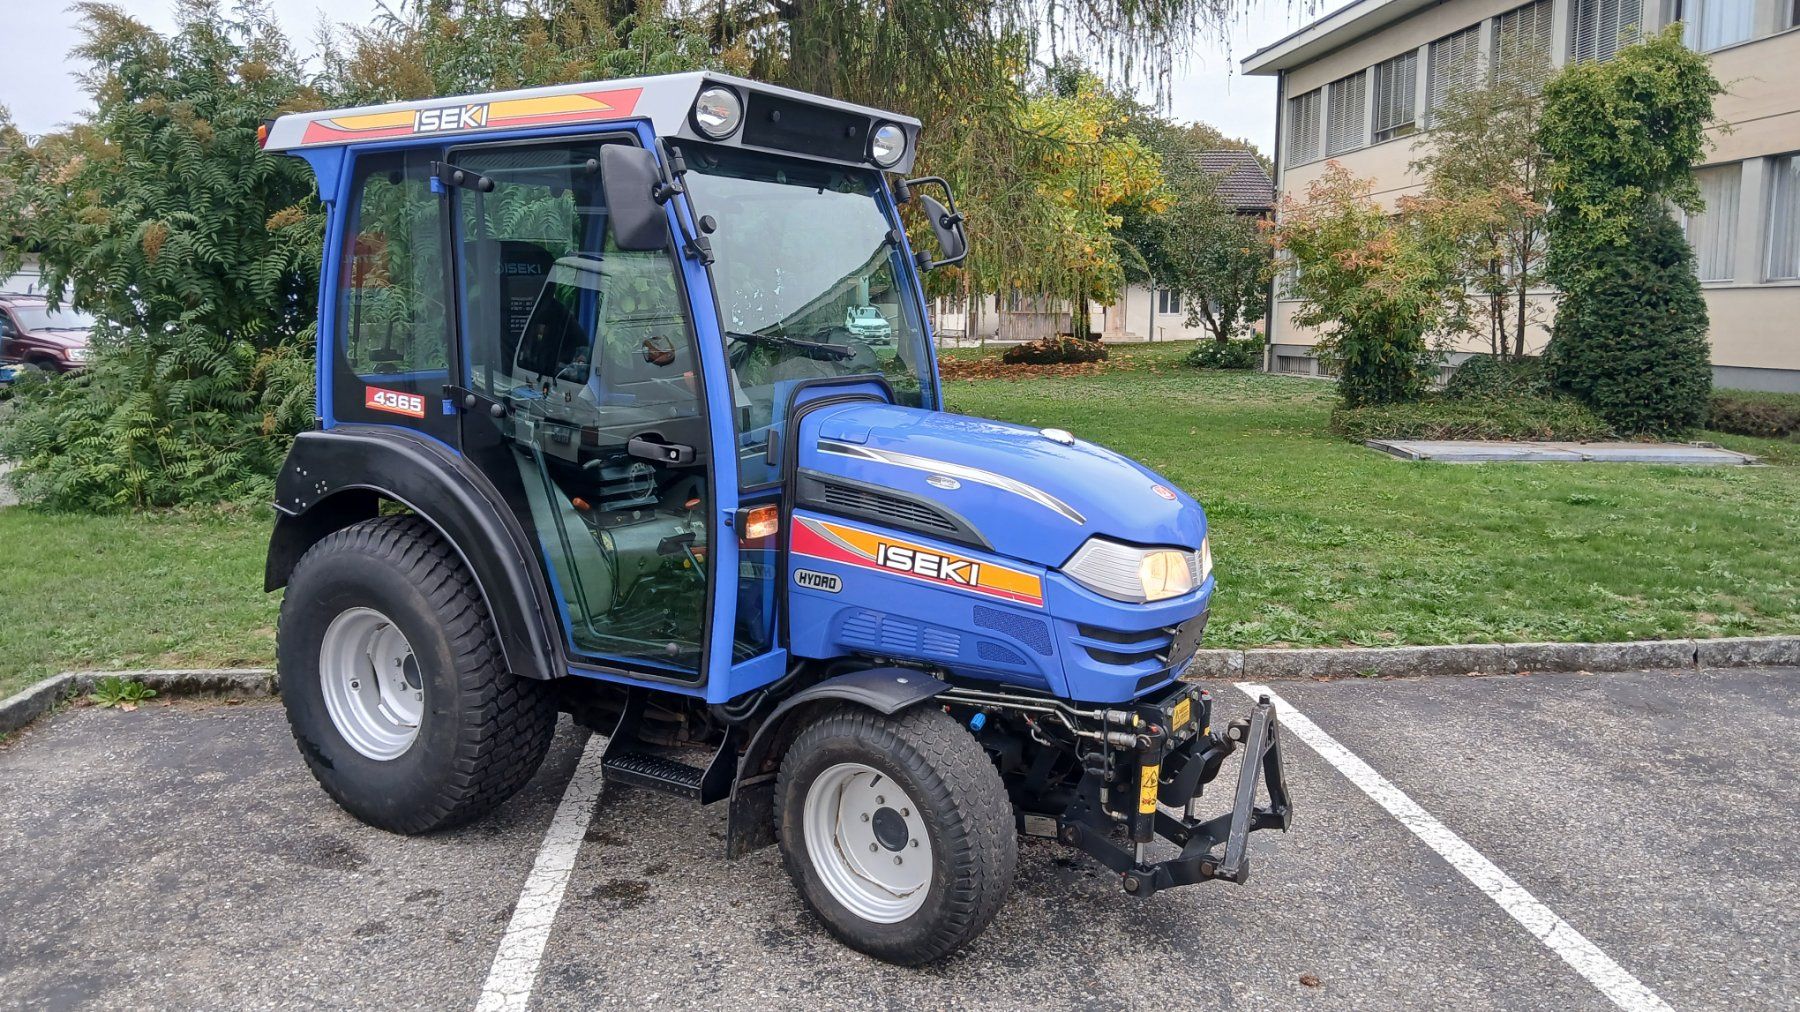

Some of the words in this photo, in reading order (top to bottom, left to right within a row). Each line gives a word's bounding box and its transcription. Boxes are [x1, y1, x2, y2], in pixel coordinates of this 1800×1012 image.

[413, 104, 489, 132] ISEKI
[504, 263, 541, 274] ISEKI
[373, 391, 422, 412] 4365
[876, 543, 980, 586] ISEKI
[799, 571, 837, 590] HYDRO
